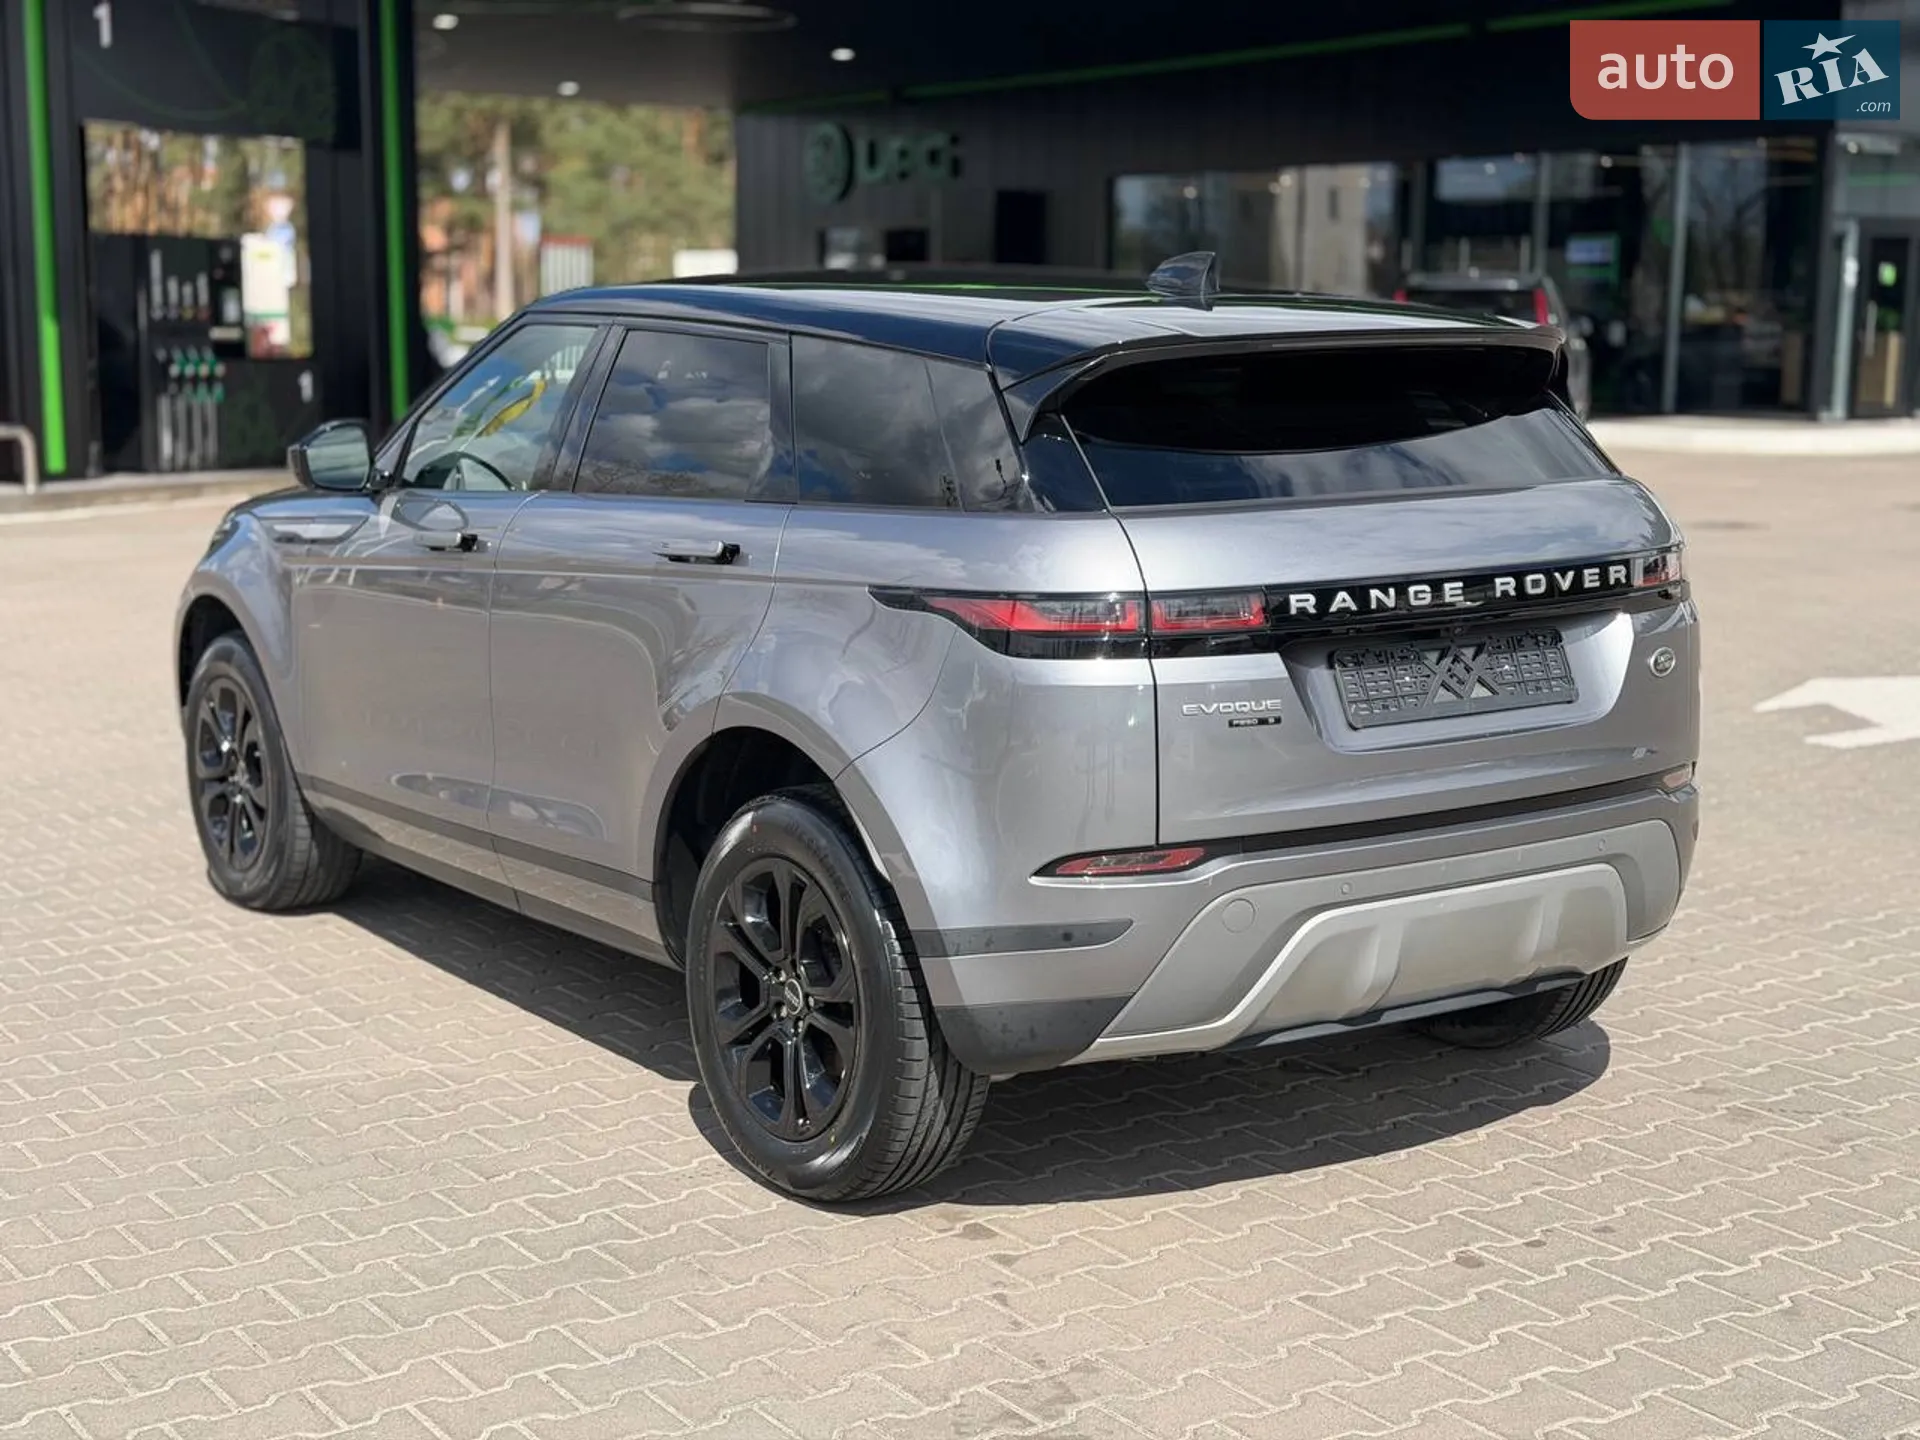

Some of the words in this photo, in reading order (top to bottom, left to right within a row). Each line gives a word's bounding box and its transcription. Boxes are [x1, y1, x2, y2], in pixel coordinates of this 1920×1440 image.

[92, 3, 112, 49] 1
[297, 369, 313, 403] 1
[1289, 581, 1464, 615] RANGE
[1494, 565, 1627, 598] ROVER
[1182, 699, 1281, 715] EVOQUE
